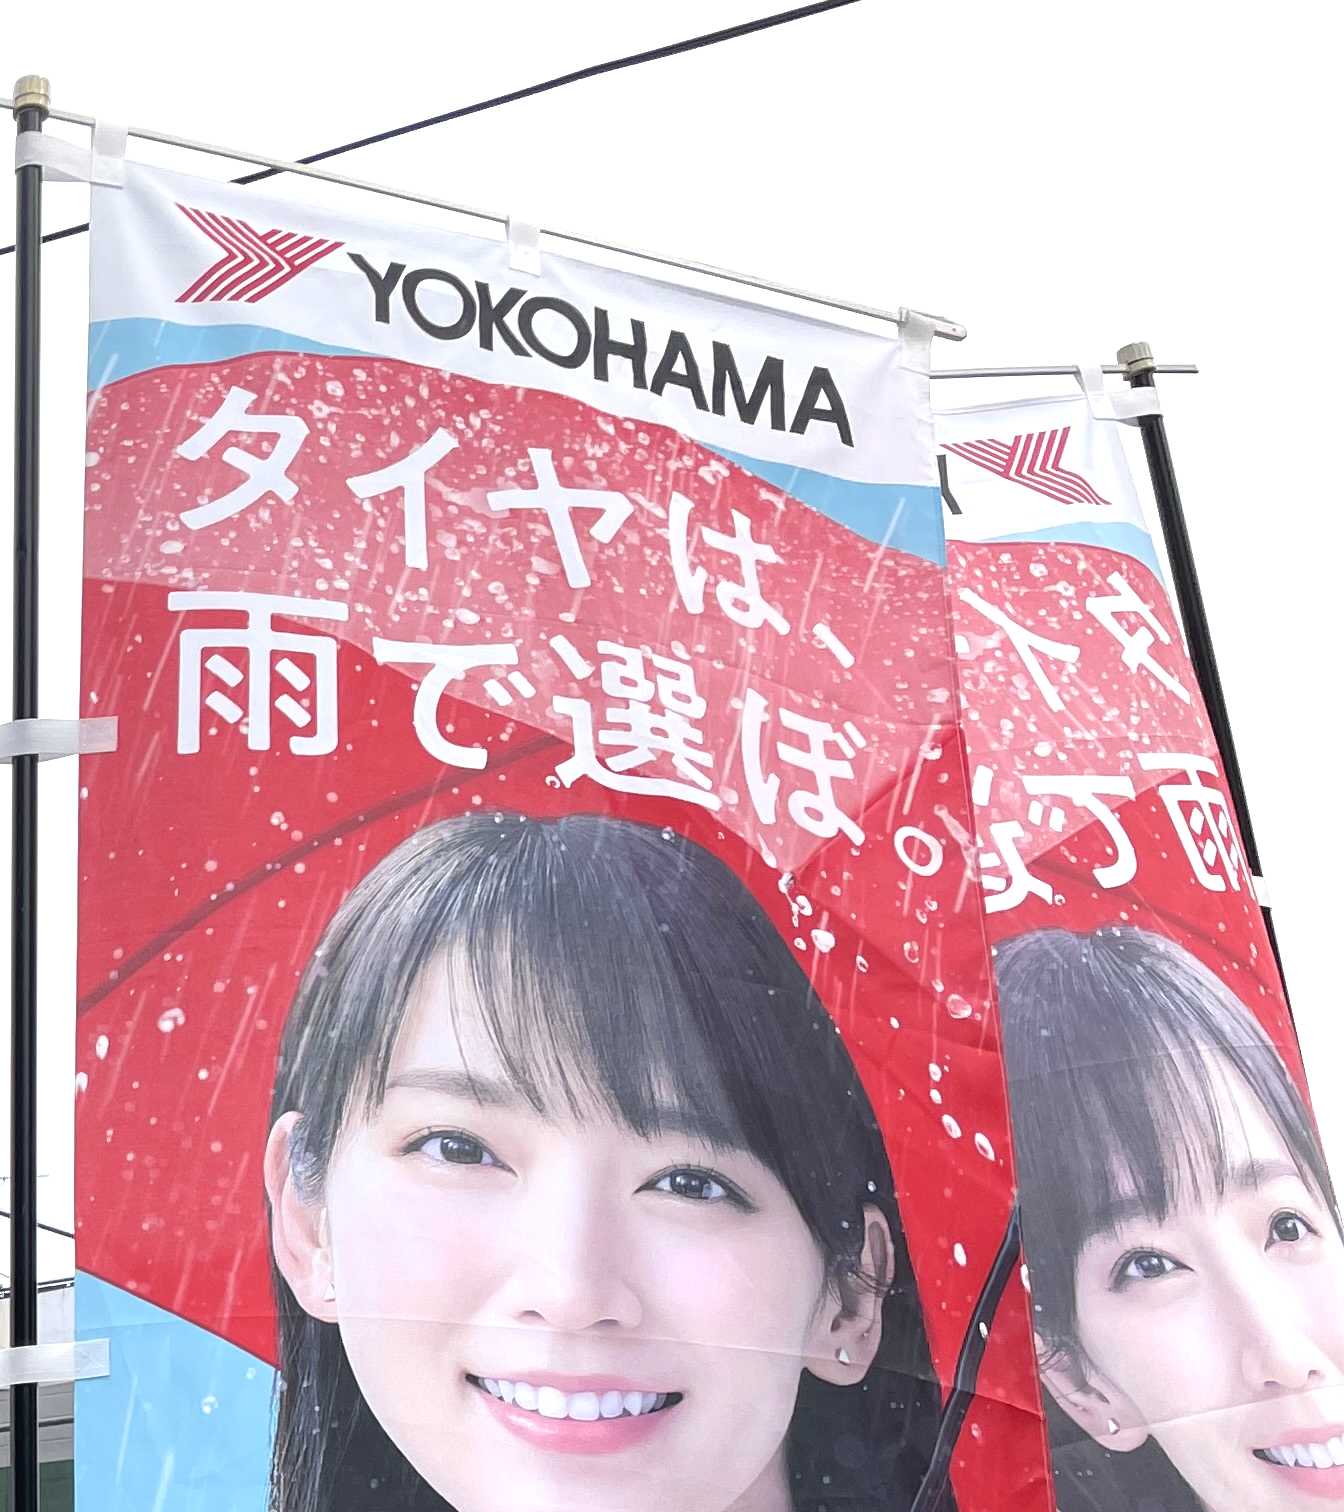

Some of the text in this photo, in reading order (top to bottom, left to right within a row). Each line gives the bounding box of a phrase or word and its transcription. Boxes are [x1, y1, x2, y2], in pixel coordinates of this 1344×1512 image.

[347, 251, 855, 448] YOKOHAMA
[176, 387, 856, 669] タイヤは、
[167, 590, 943, 878] 雨で選ぼ。
